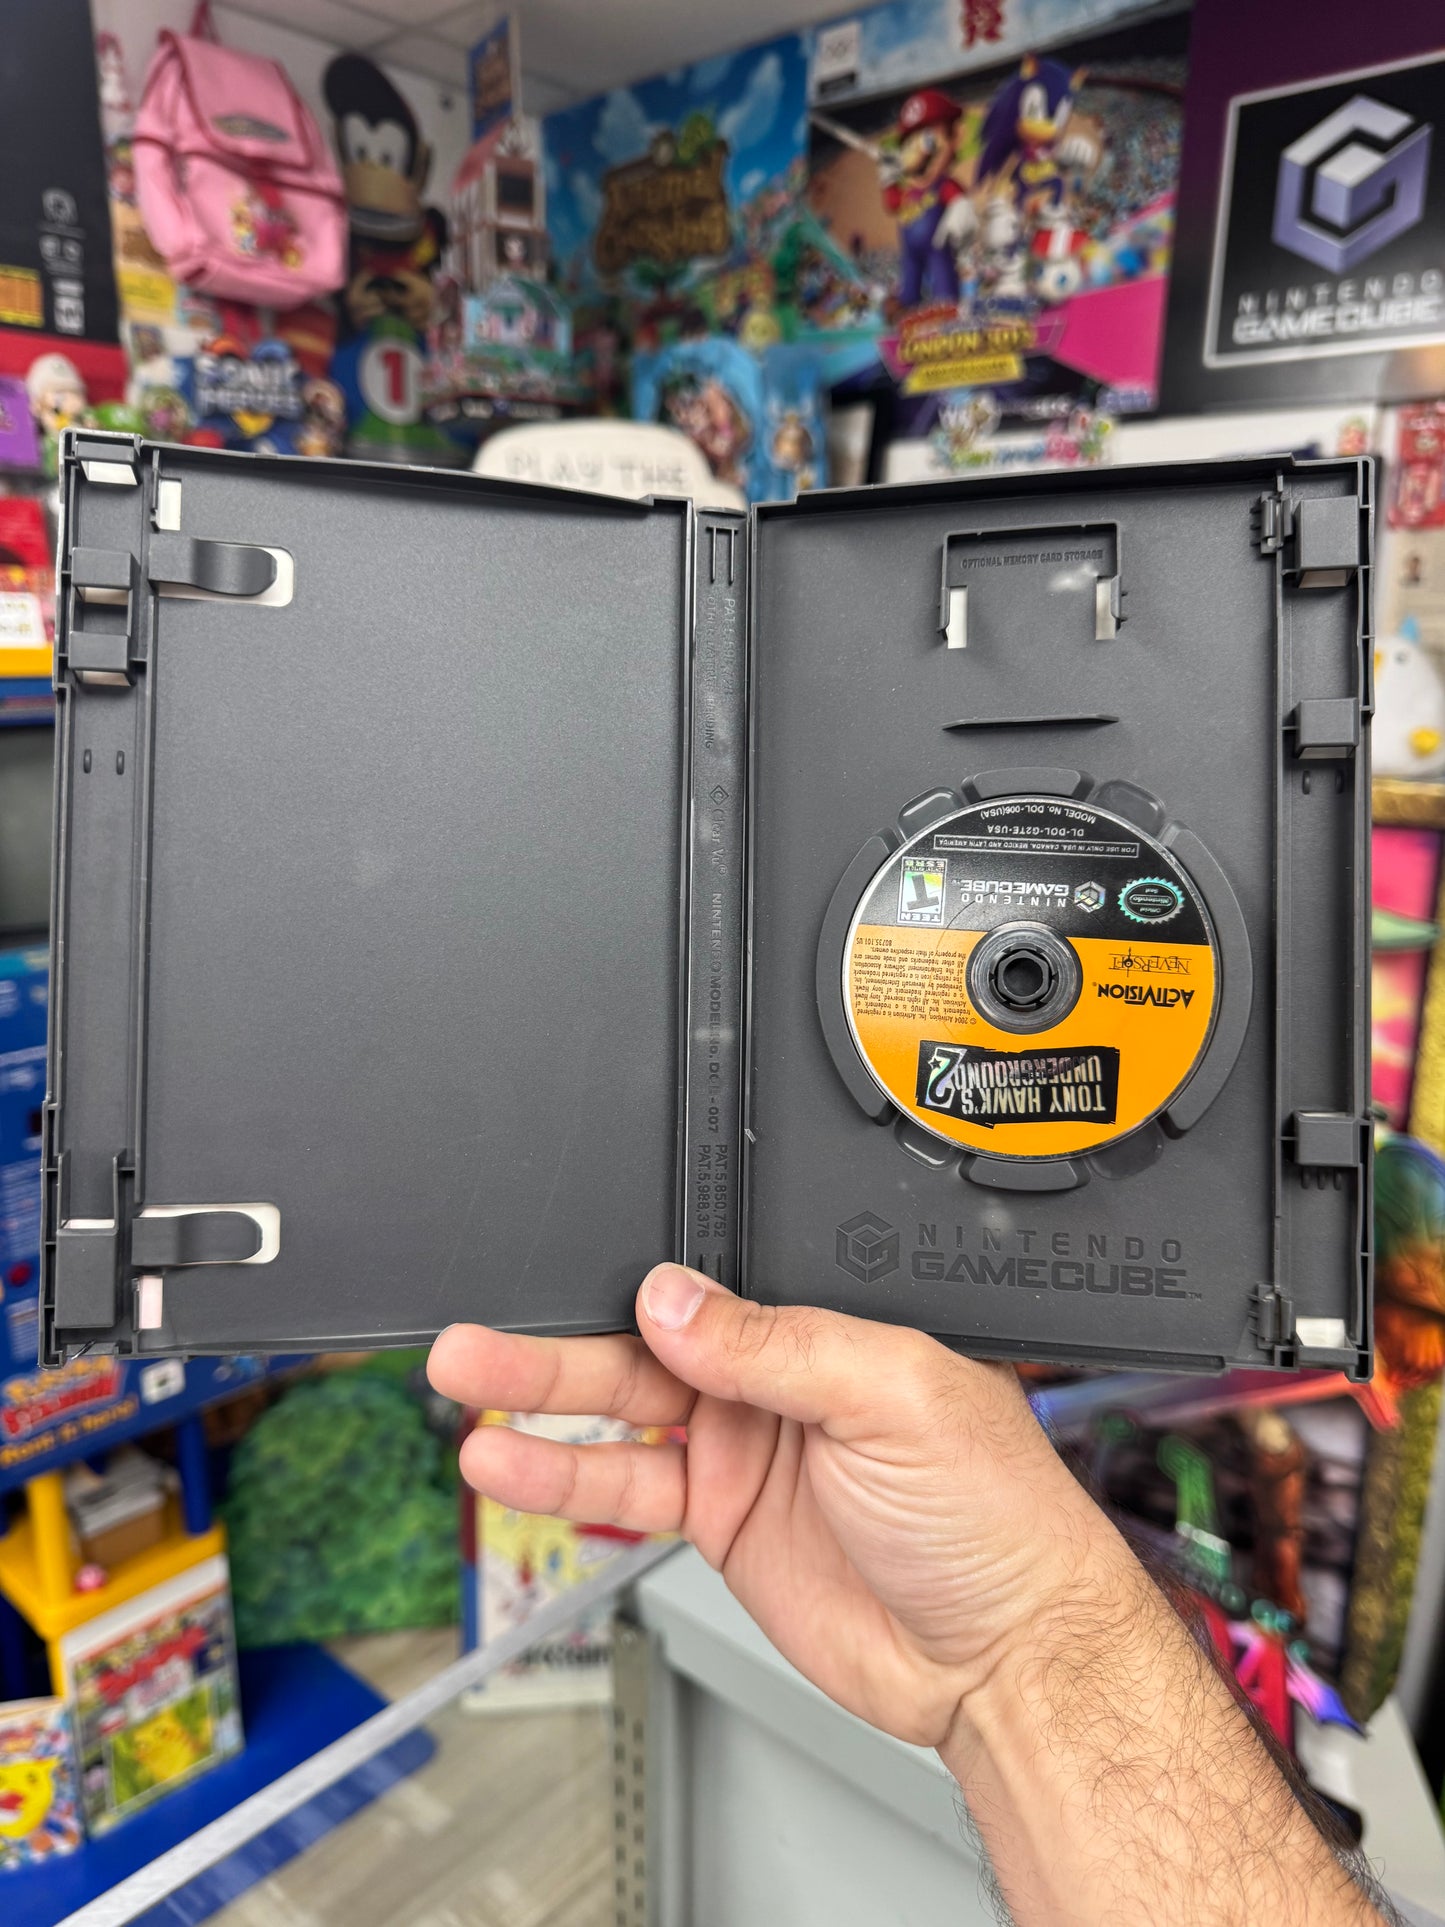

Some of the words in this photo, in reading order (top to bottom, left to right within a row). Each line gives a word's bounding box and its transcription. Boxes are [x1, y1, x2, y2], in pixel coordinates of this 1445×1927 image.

[1238, 269, 1442, 315] NINTENDO
[1232, 295, 1445, 344] GAMECUBE
[962, 557, 1001, 568] OPTIONAL
[1003, 554, 1039, 566] MEMORY
[1040, 552, 1062, 563] CARD
[1063, 549, 1103, 561] STORAGE
[1047, 806, 1062, 815] No.
[1065, 808, 1096, 824] MODEL
[907, 874, 939, 910] T
[960, 893, 1066, 908] NINTENDO
[1132, 895, 1170, 904] Nintendo
[901, 912, 941, 921] TEEN
[710, 893, 721, 972] NINTENDO
[951, 1055, 1102, 1090] UNDERGROUND
[961, 1086, 1041, 1115] HAWK'S
[1049, 1084, 1106, 1113] TONY
[918, 1223, 1182, 1264] NINTENDO
